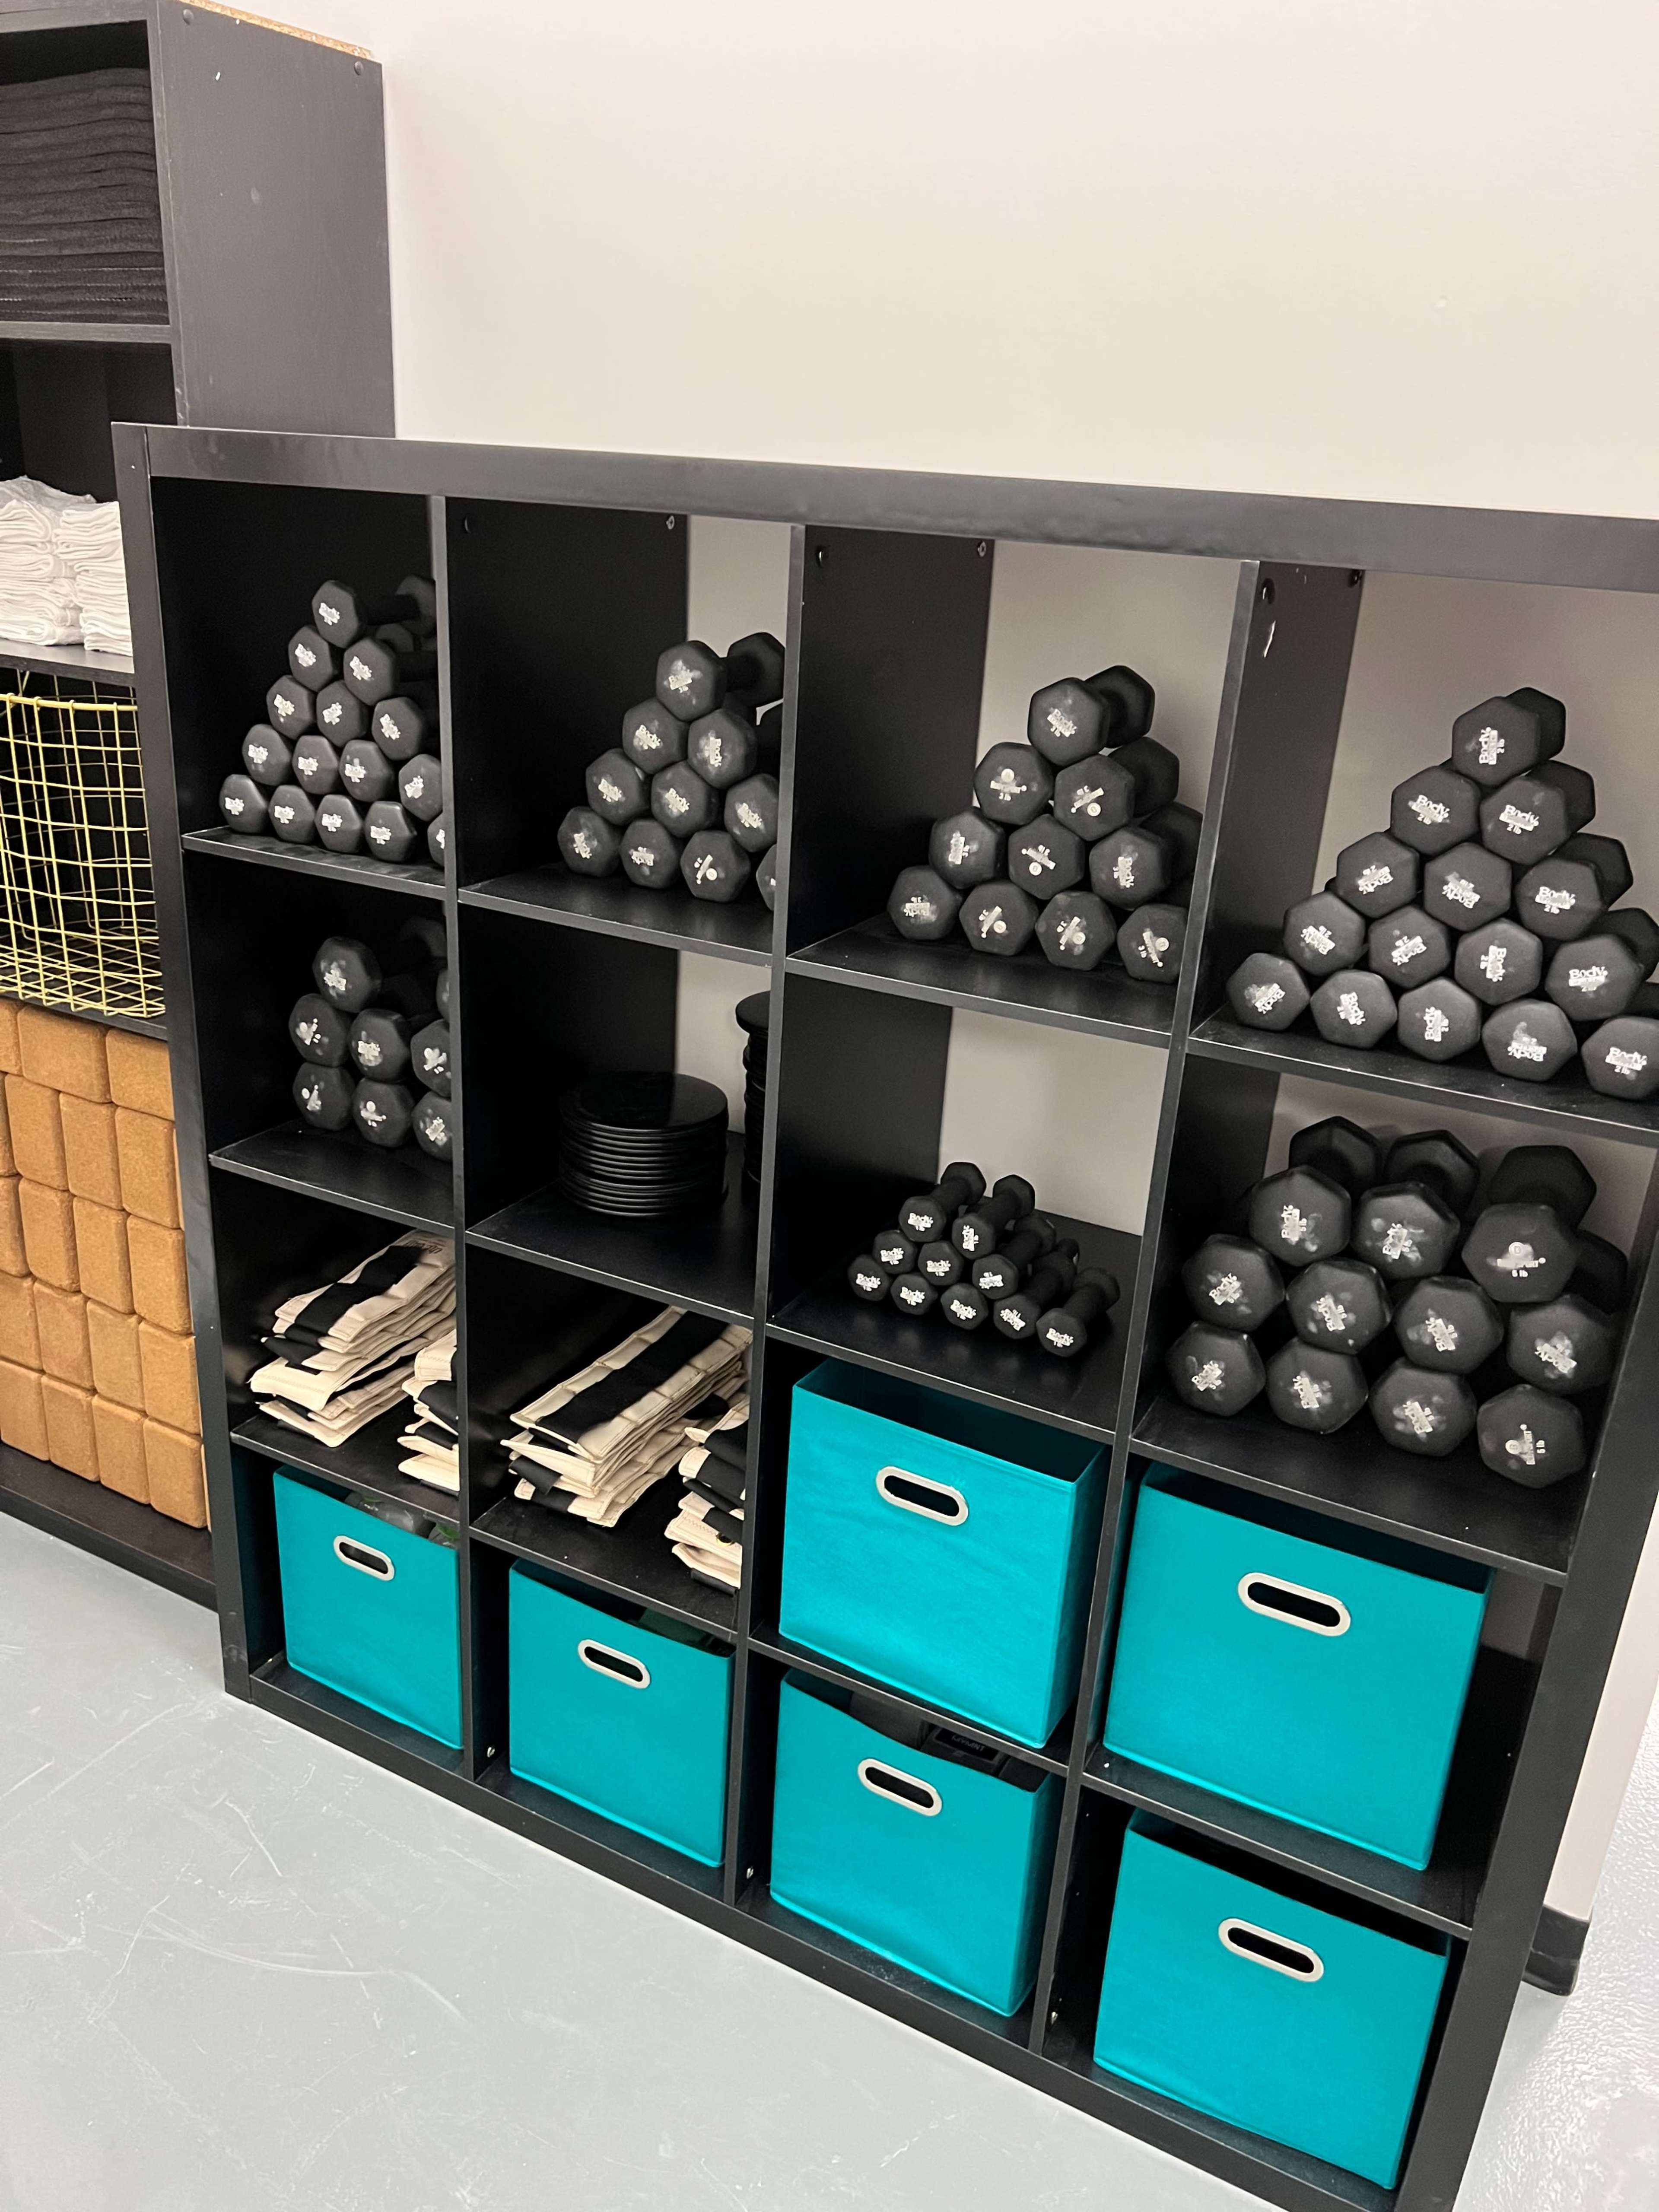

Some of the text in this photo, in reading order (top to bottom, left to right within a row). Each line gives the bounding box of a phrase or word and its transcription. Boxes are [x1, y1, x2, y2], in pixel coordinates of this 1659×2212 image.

[1479, 729, 1489, 764] Body
[1417, 795, 1450, 814] Body
[1504, 804, 1539, 823] Body
[1442, 888, 1476, 909] Body
[1539, 886, 1576, 900] Body
[1569, 966, 1606, 977] Body
[1347, 992, 1366, 1023] Body
[1423, 1007, 1435, 1040] Body
[1508, 1047, 1544, 1062] Body
[857, 1273, 880, 1285] Body
[1208, 1272, 1233, 1298] Body
[902, 1286, 925, 1299] Body
[953, 1299, 976, 1314] Body
[1049, 1328, 1074, 1342] Body
